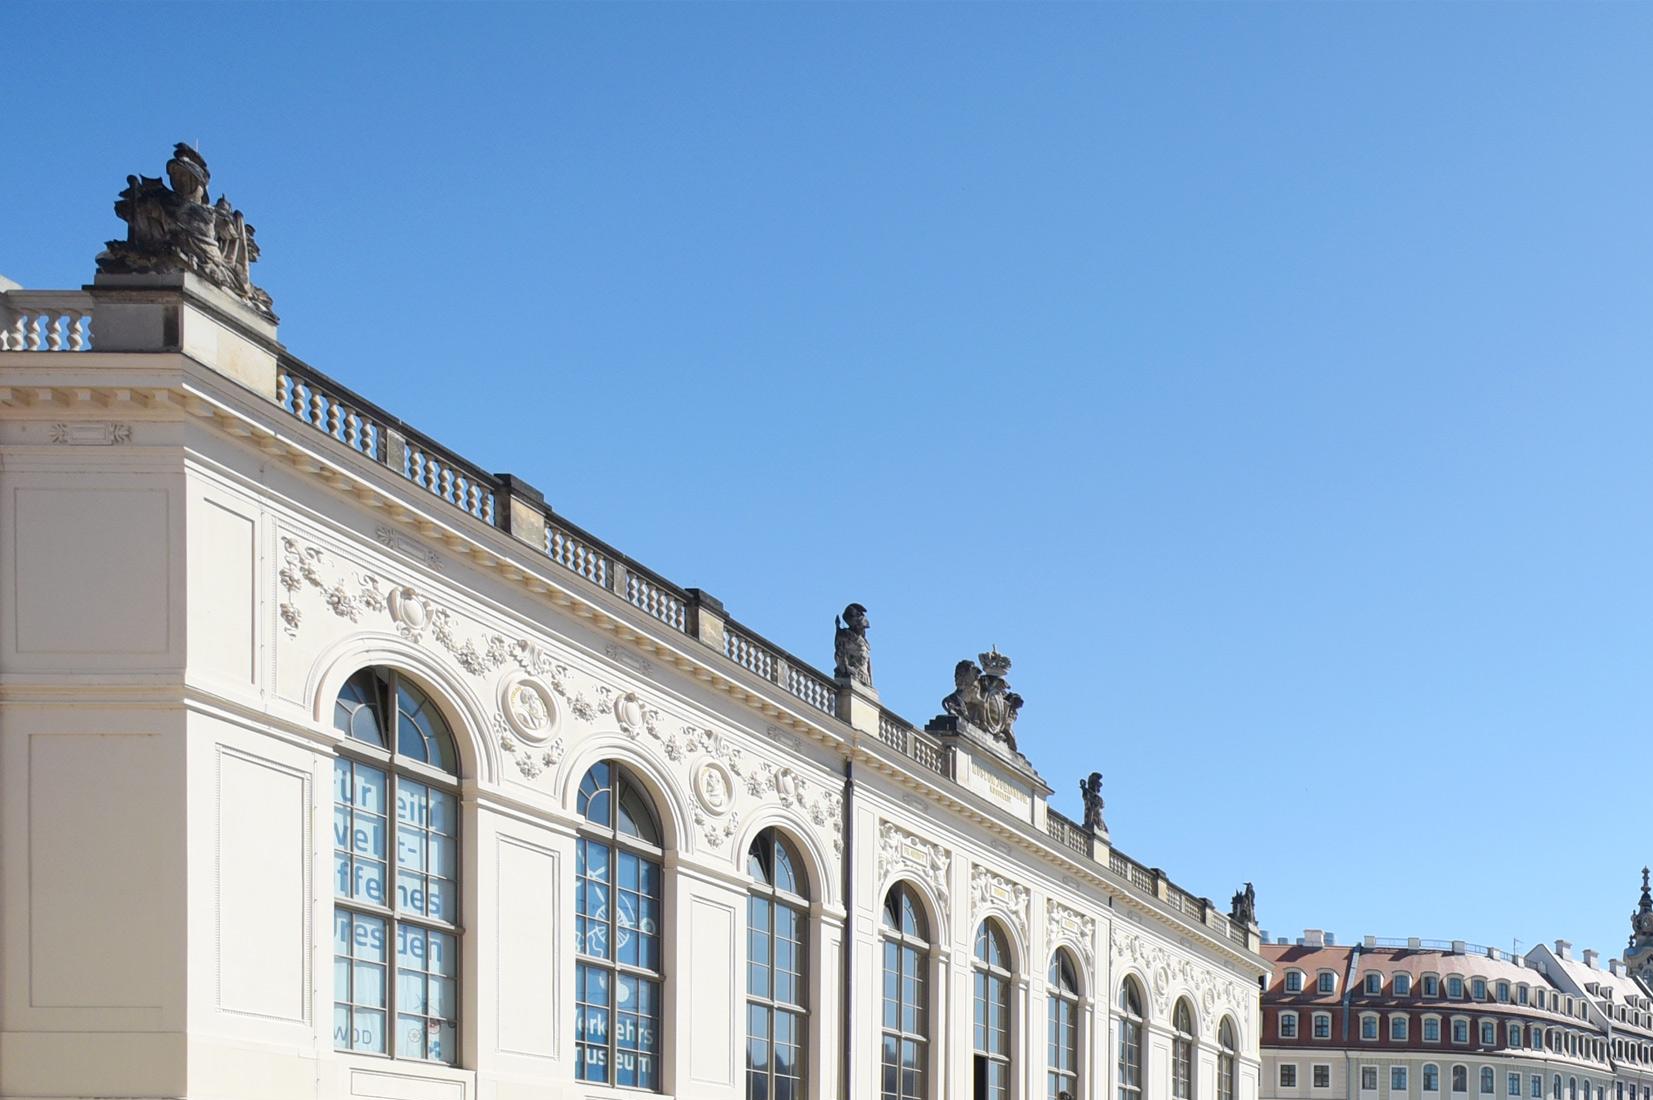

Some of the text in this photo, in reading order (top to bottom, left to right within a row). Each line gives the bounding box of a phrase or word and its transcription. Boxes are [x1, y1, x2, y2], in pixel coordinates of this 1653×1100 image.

[334, 766, 442, 829] ür ein
[334, 861, 440, 914] ffenes
[576, 1009, 653, 1044] erkehrs
